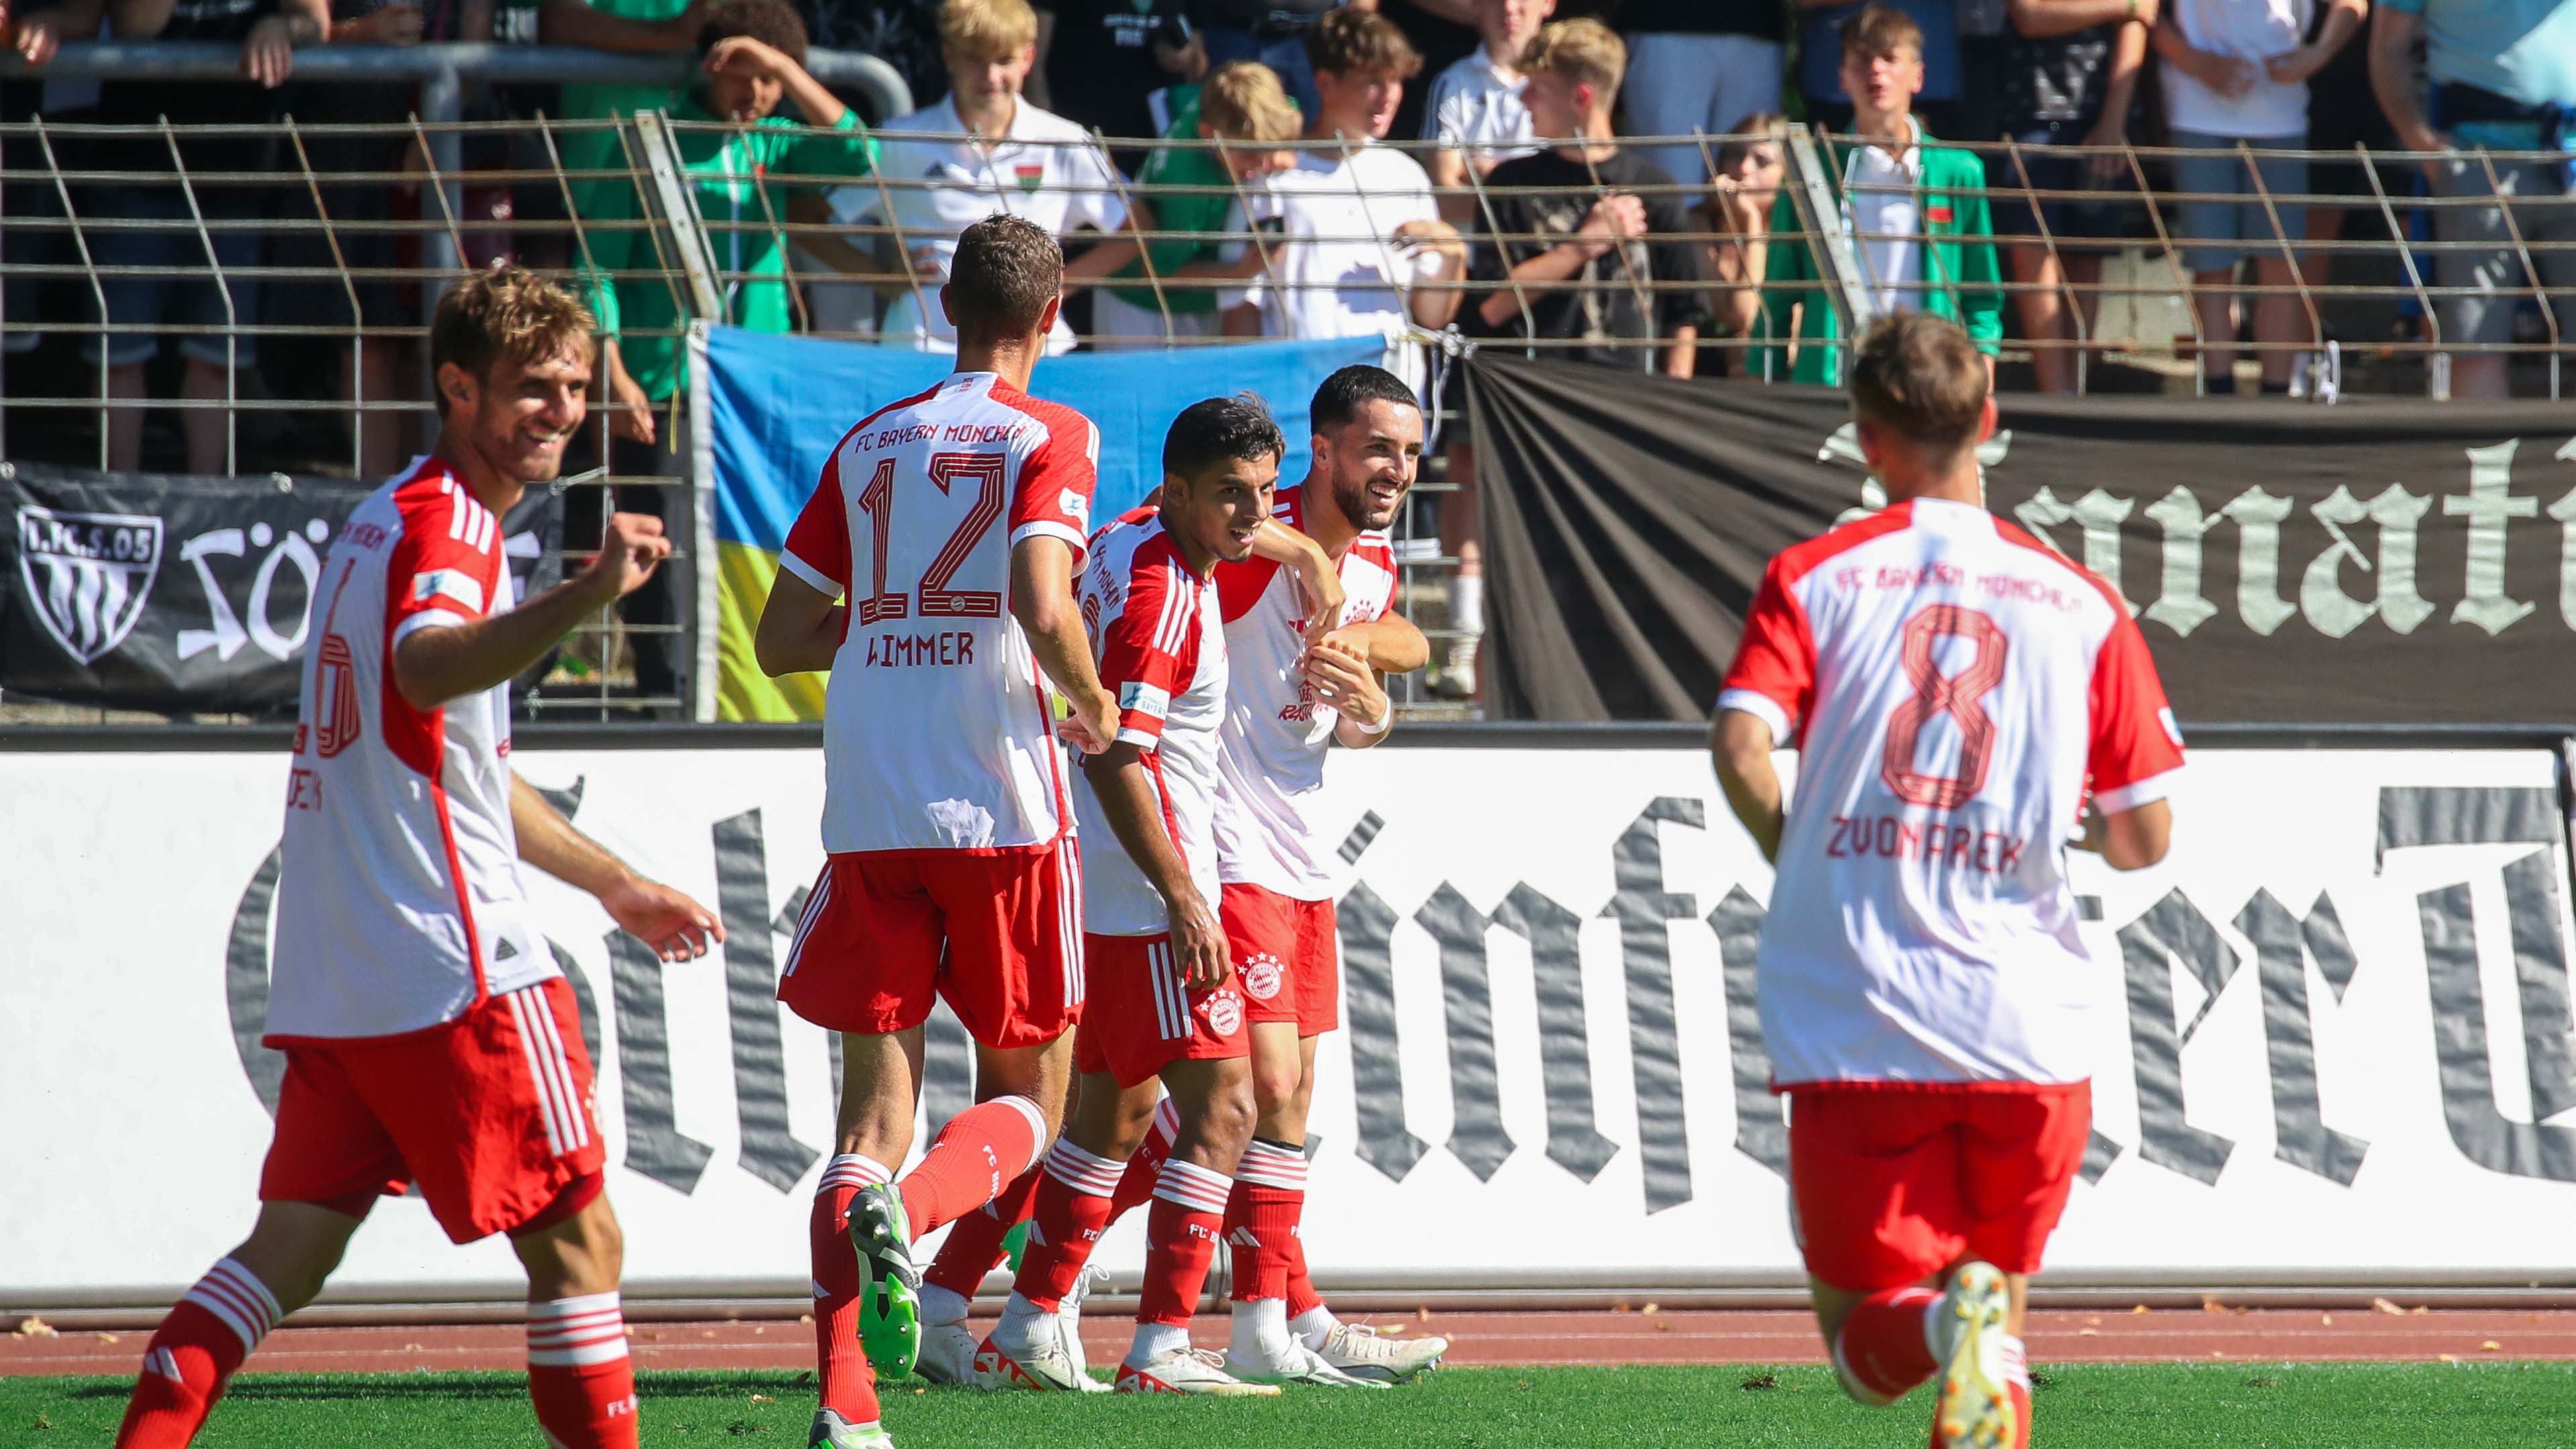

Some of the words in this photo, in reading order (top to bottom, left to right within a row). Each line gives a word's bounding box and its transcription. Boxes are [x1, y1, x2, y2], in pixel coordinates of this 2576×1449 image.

[854, 432, 875, 454] FC
[877, 424, 940, 449] BAYERN
[943, 424, 1026, 443] MÜNCHEN
[858, 452, 1006, 627] 12
[294, 556, 362, 760] 6
[1881, 603, 2007, 810] 8
[1826, 814, 2025, 875] ZVONAREK
[1189, 1223, 1208, 1239] FC
